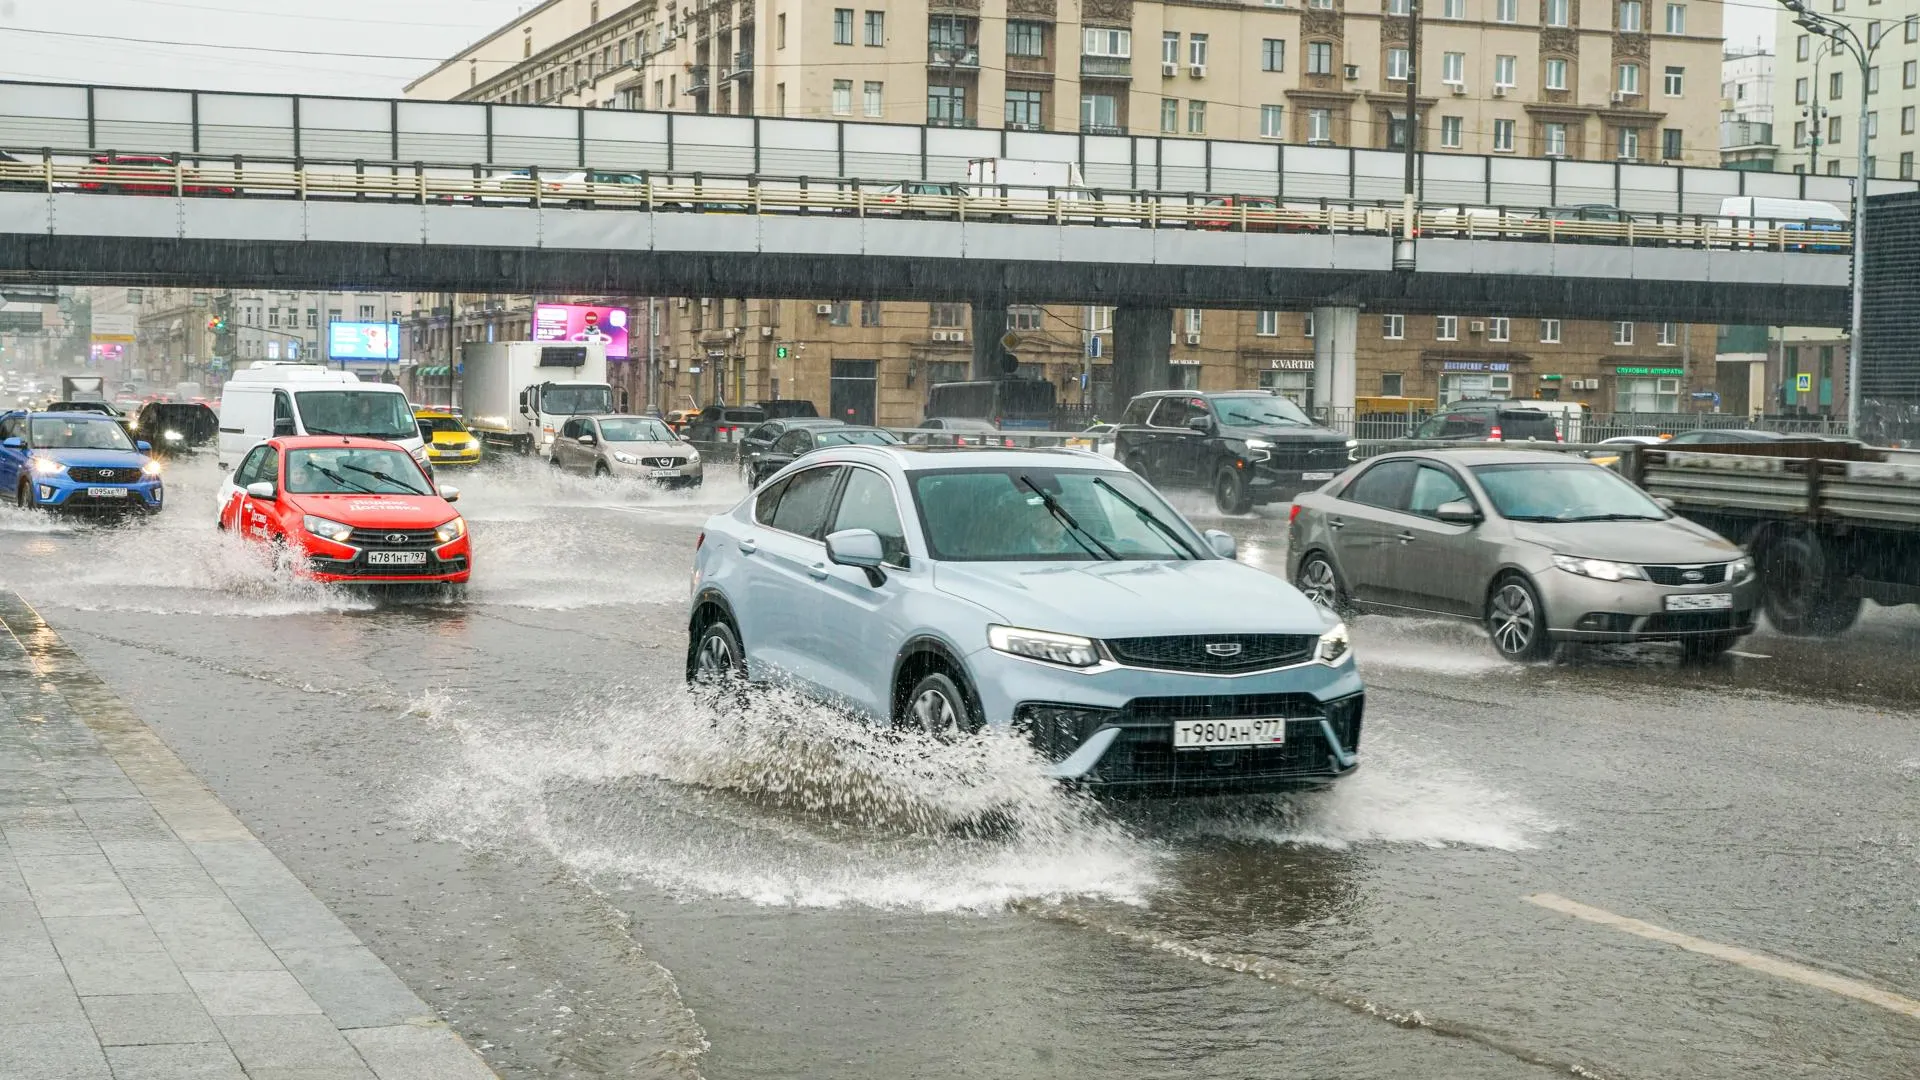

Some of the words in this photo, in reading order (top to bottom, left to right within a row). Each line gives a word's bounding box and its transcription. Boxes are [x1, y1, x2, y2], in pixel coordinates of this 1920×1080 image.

[410, 552, 425, 560] 797
[1182, 723, 1251, 743] Т980АН
[1253, 719, 1280, 736] 977
